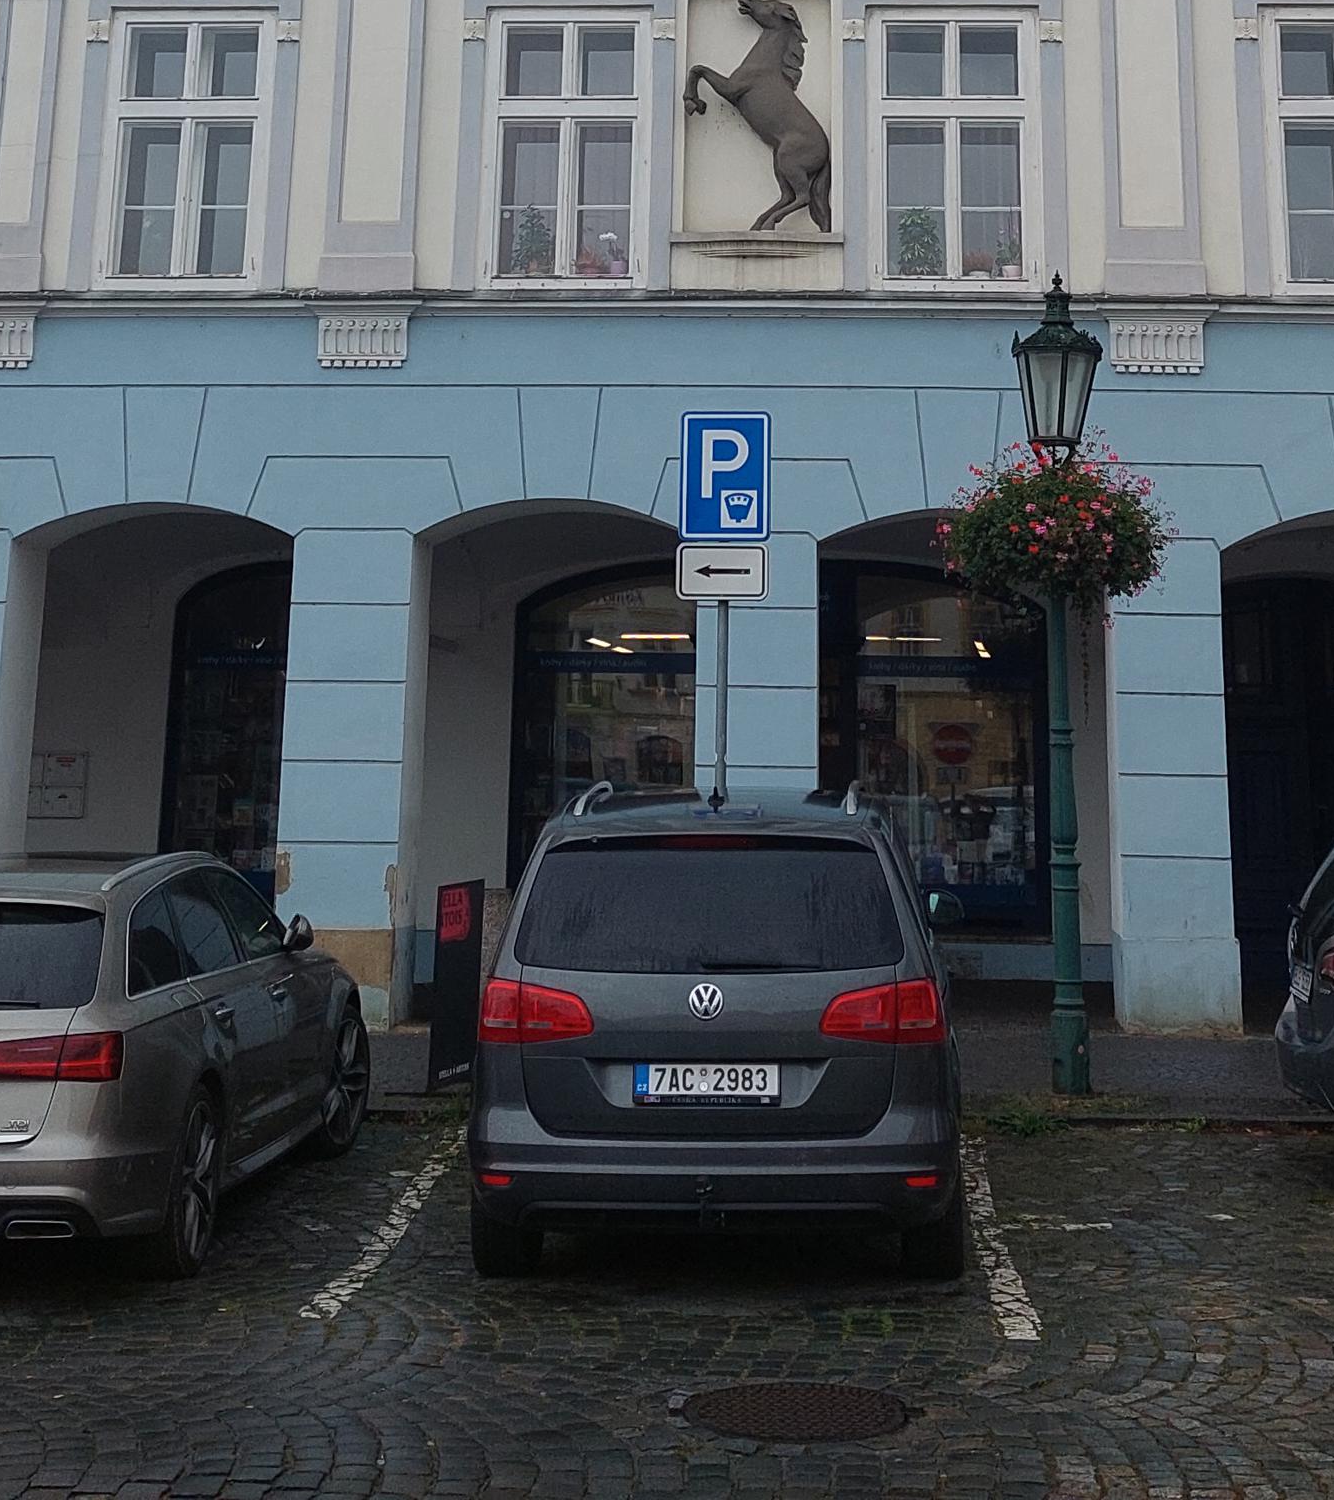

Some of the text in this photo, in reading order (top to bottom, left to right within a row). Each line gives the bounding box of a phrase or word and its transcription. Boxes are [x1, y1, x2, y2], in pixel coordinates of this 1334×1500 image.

[701, 429, 749, 498] P
[636, 1084, 648, 1092] CZ
[654, 1067, 768, 1092] 7AC 2983
